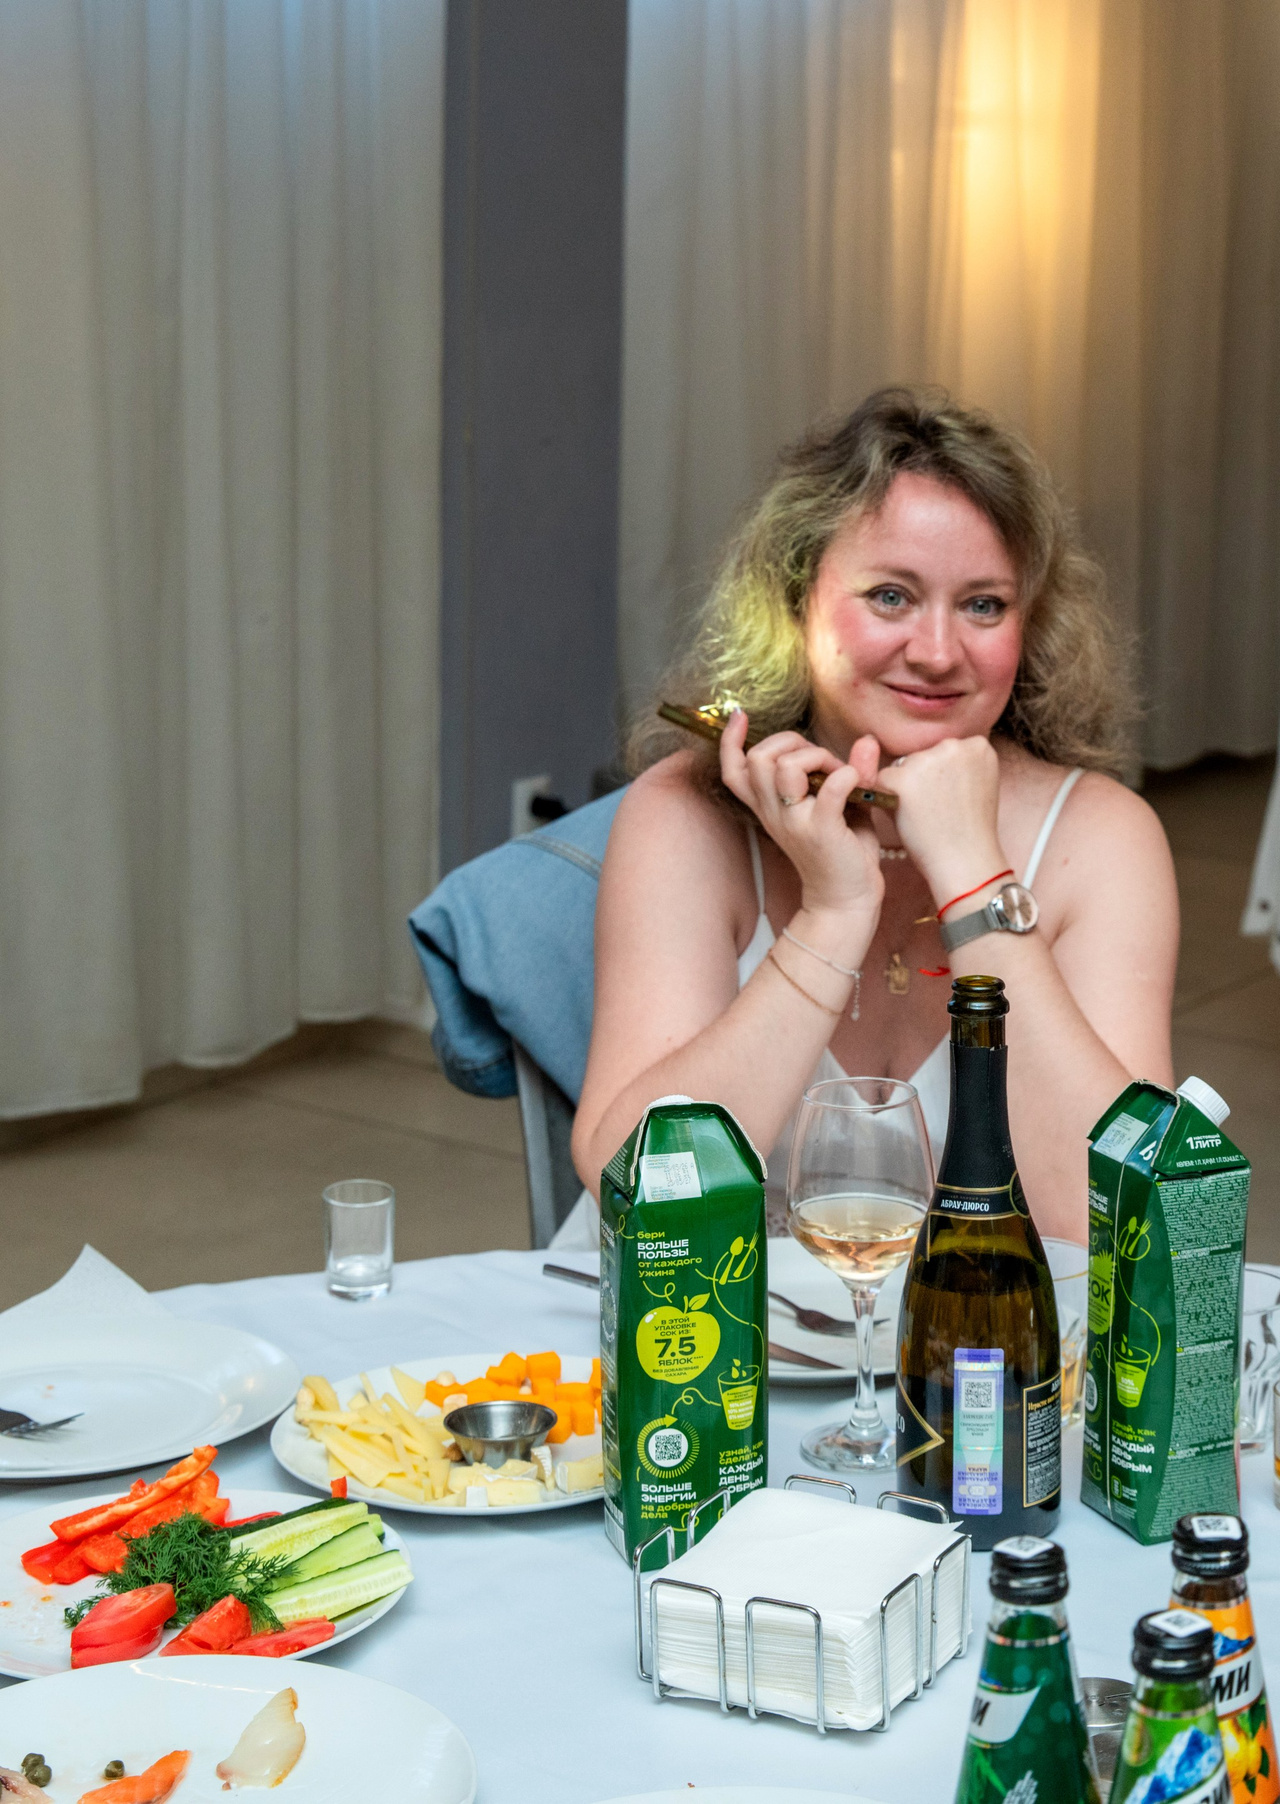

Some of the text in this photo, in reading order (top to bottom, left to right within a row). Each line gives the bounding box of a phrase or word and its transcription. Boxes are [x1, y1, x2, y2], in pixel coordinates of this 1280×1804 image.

[1194, 1139, 1222, 1149] ЛИТР
[941, 1198, 989, 1212] АБРАУ-ДЮРСО
[637, 1231, 666, 1240] бери
[637, 1239, 689, 1251] БОЛЬШЕ
[637, 1248, 689, 1260] ПОЛЬЗЫ
[653, 1257, 703, 1268] каждого
[638, 1268, 676, 1278] ужина
[654, 1322, 697, 1331] УПАКОВКЕ
[668, 1316, 690, 1325] ЭТОЙ
[660, 1329, 677, 1337] СОК
[654, 1336, 697, 1358] 7.5
[1111, 1435, 1155, 1454] КАЖДЫЙ
[719, 1446, 751, 1459] узнай,
[719, 1451, 758, 1465] сделать
[1111, 1444, 1132, 1461] ДЕНЬ
[719, 1455, 764, 1475] КАЖДЫЙ
[1111, 1454, 1152, 1474] ДОБРЫМ
[719, 1474, 749, 1486] ДЕНЬ
[728, 1476, 764, 1494] ОБРЫМ
[641, 1482, 692, 1493] БОЛЬШЕ
[641, 1492, 697, 1503] ЭНЕРГИИ
[1211, 1660, 1251, 1703] МИ
